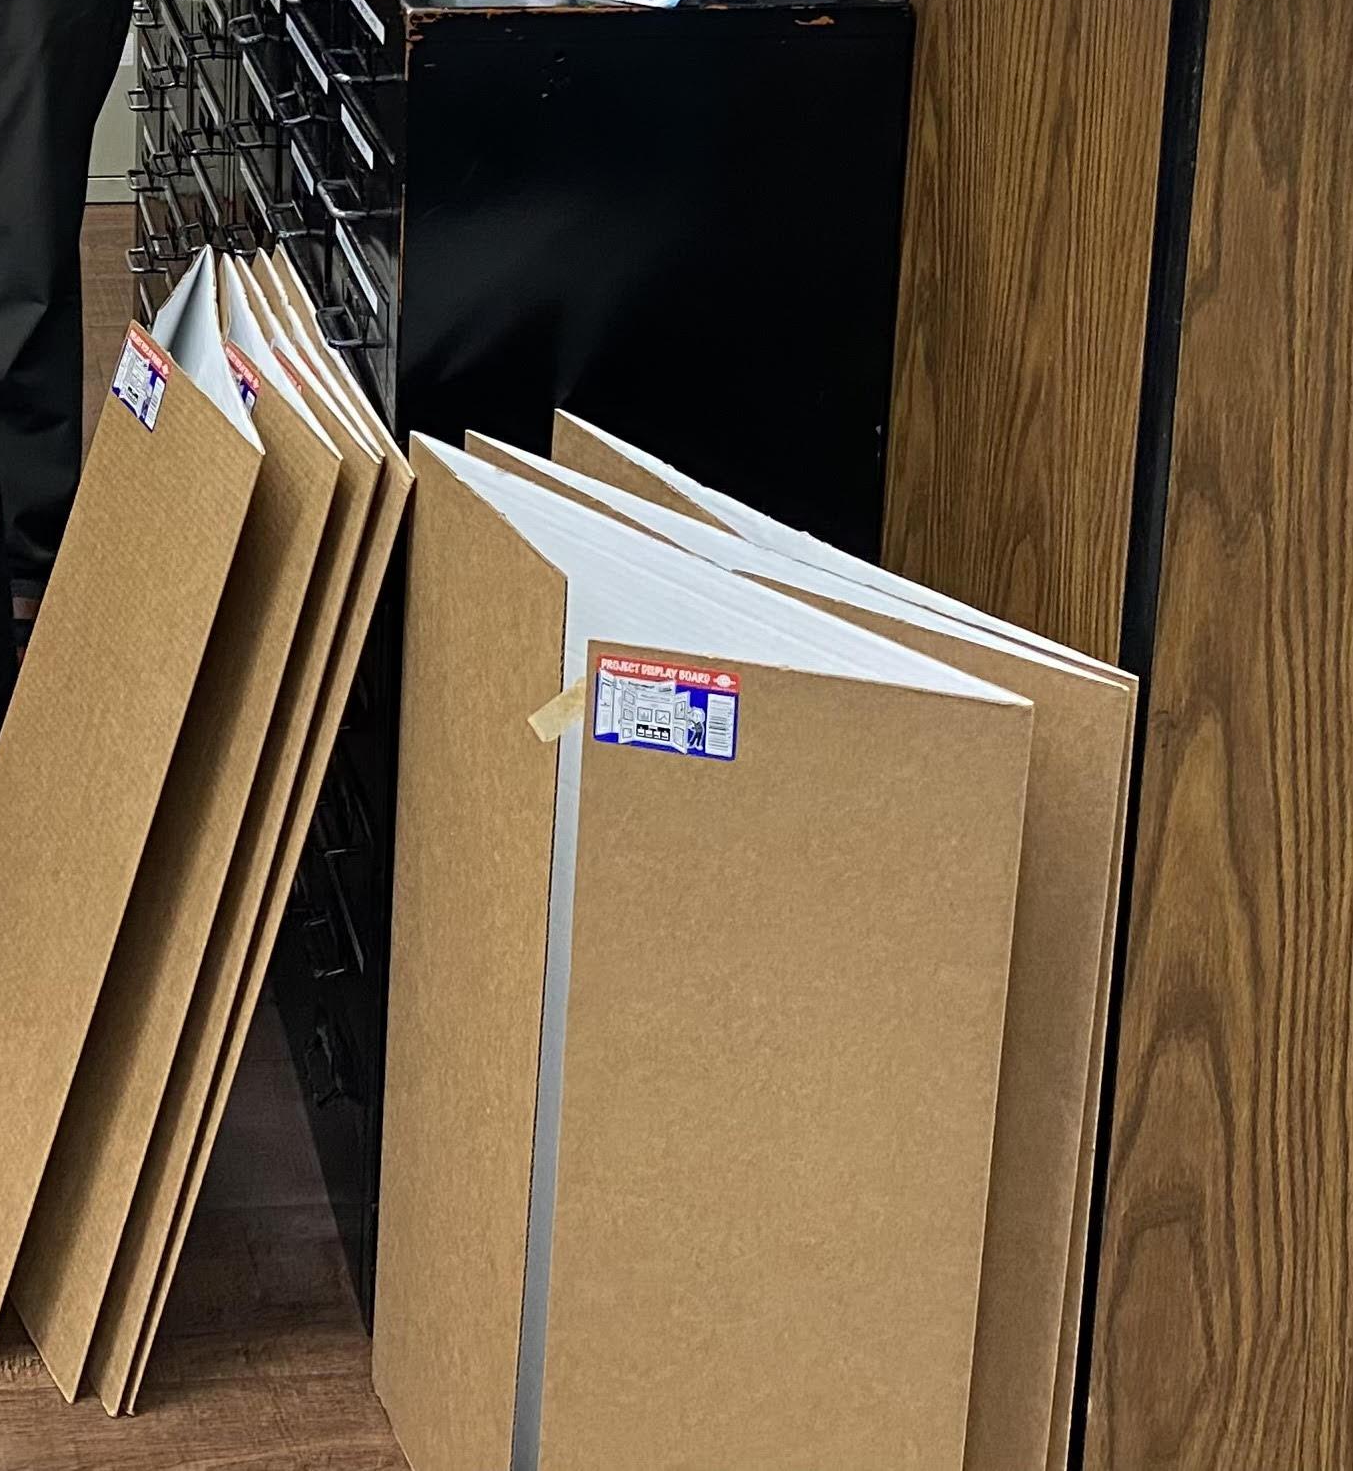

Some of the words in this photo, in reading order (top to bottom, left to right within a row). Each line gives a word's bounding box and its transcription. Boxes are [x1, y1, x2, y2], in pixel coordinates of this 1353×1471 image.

[600, 658, 640, 674] PROJECT
[641, 663, 678, 679] DISPLAY
[679, 670, 711, 685] BOARD
